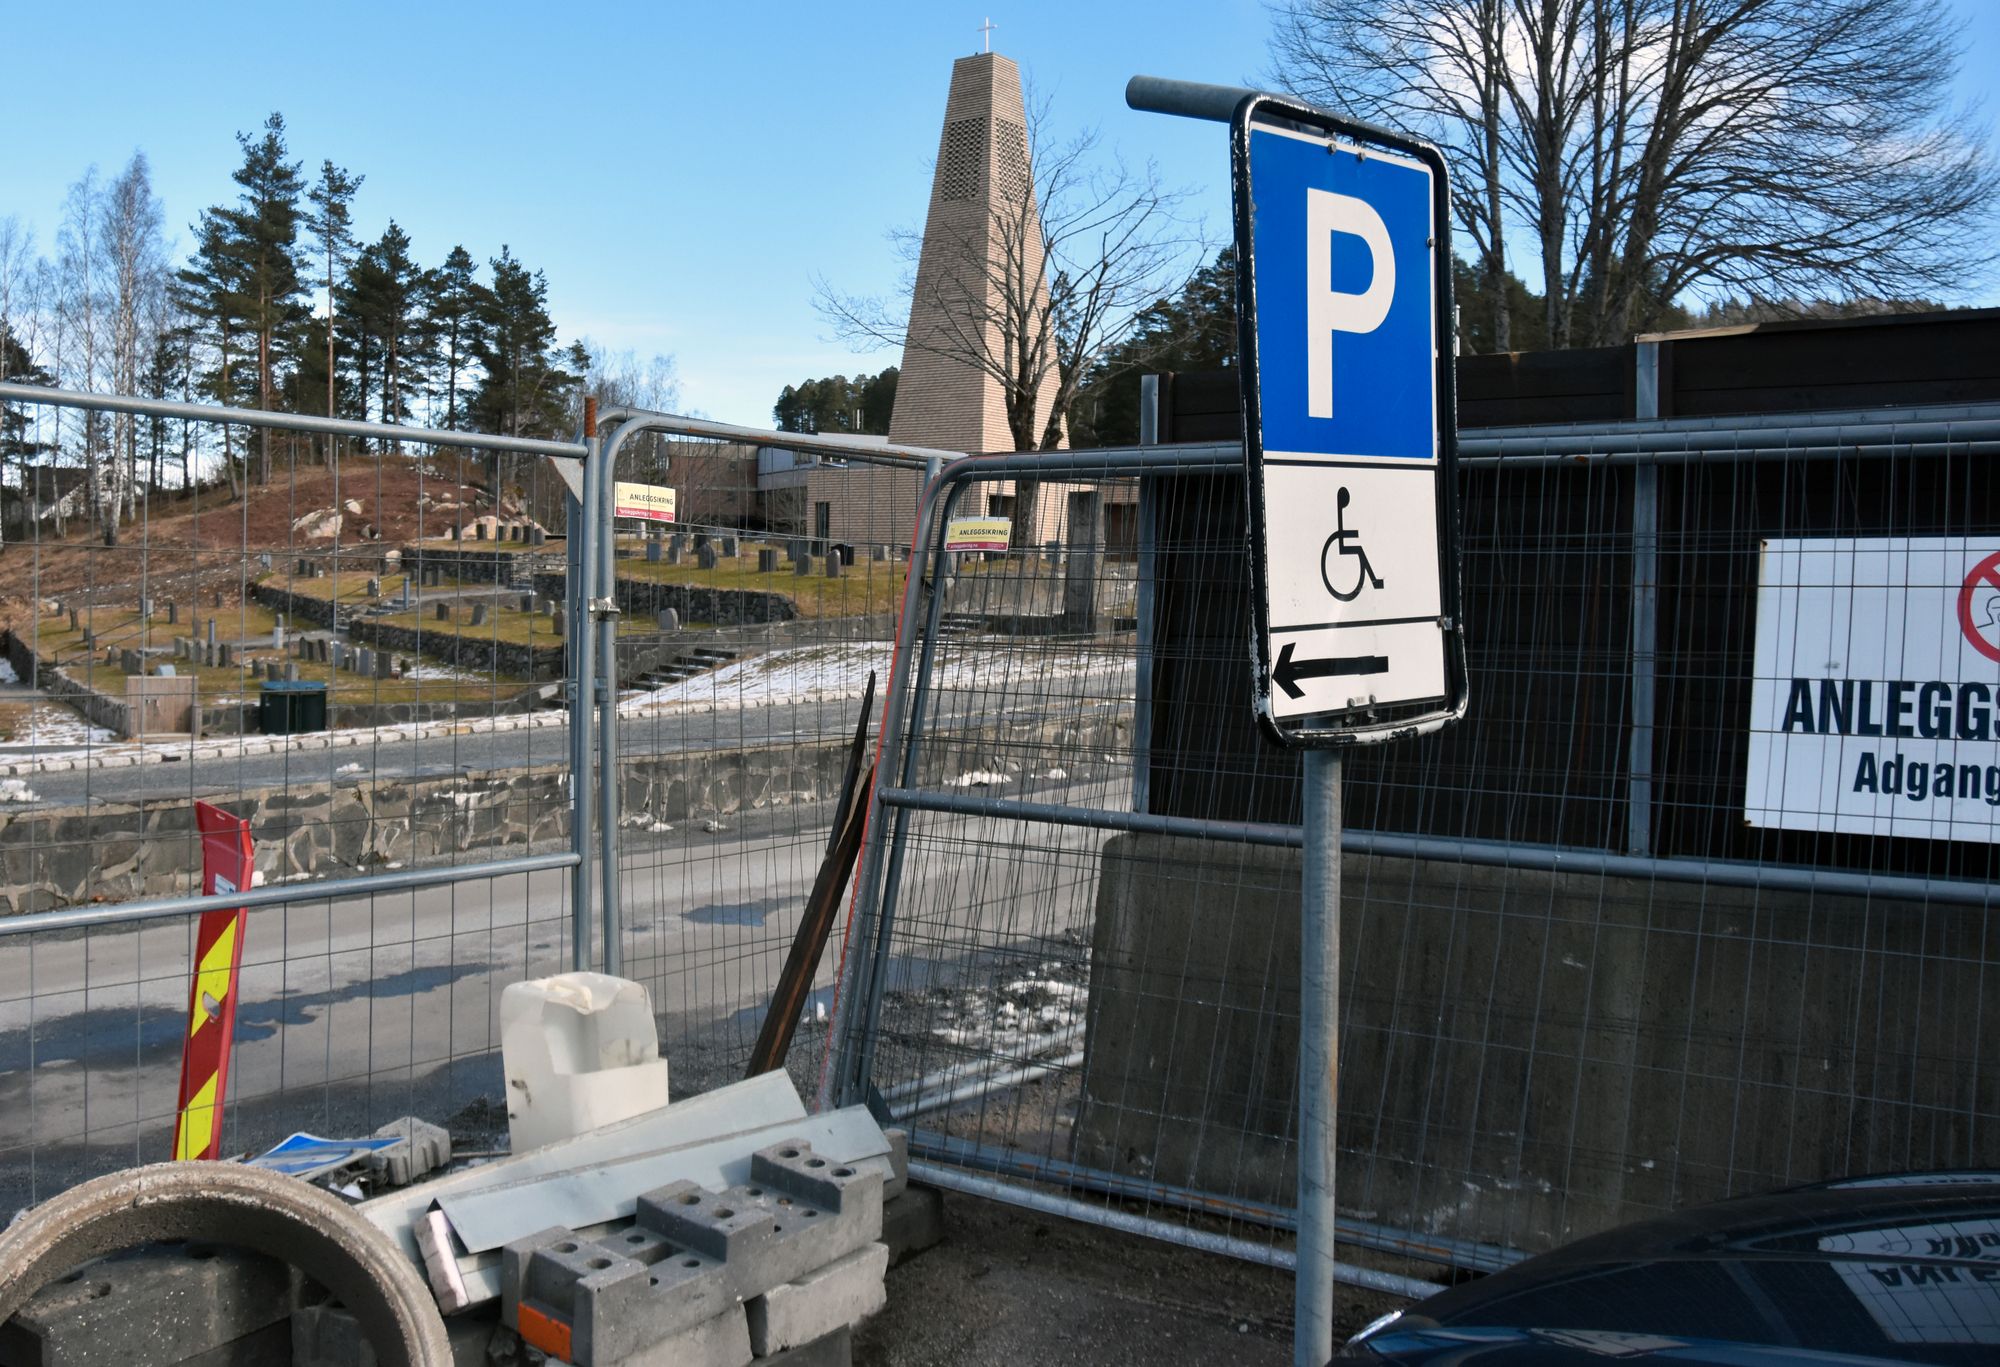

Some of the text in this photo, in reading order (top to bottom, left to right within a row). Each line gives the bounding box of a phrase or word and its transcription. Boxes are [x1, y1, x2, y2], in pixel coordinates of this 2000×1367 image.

[1306, 186, 1396, 420] P
[629, 493, 674, 505] ANLEGGSIKRING
[959, 528, 1008, 536] ANLEGGSIKRING
[1781, 677, 2000, 740] ANLEGG
